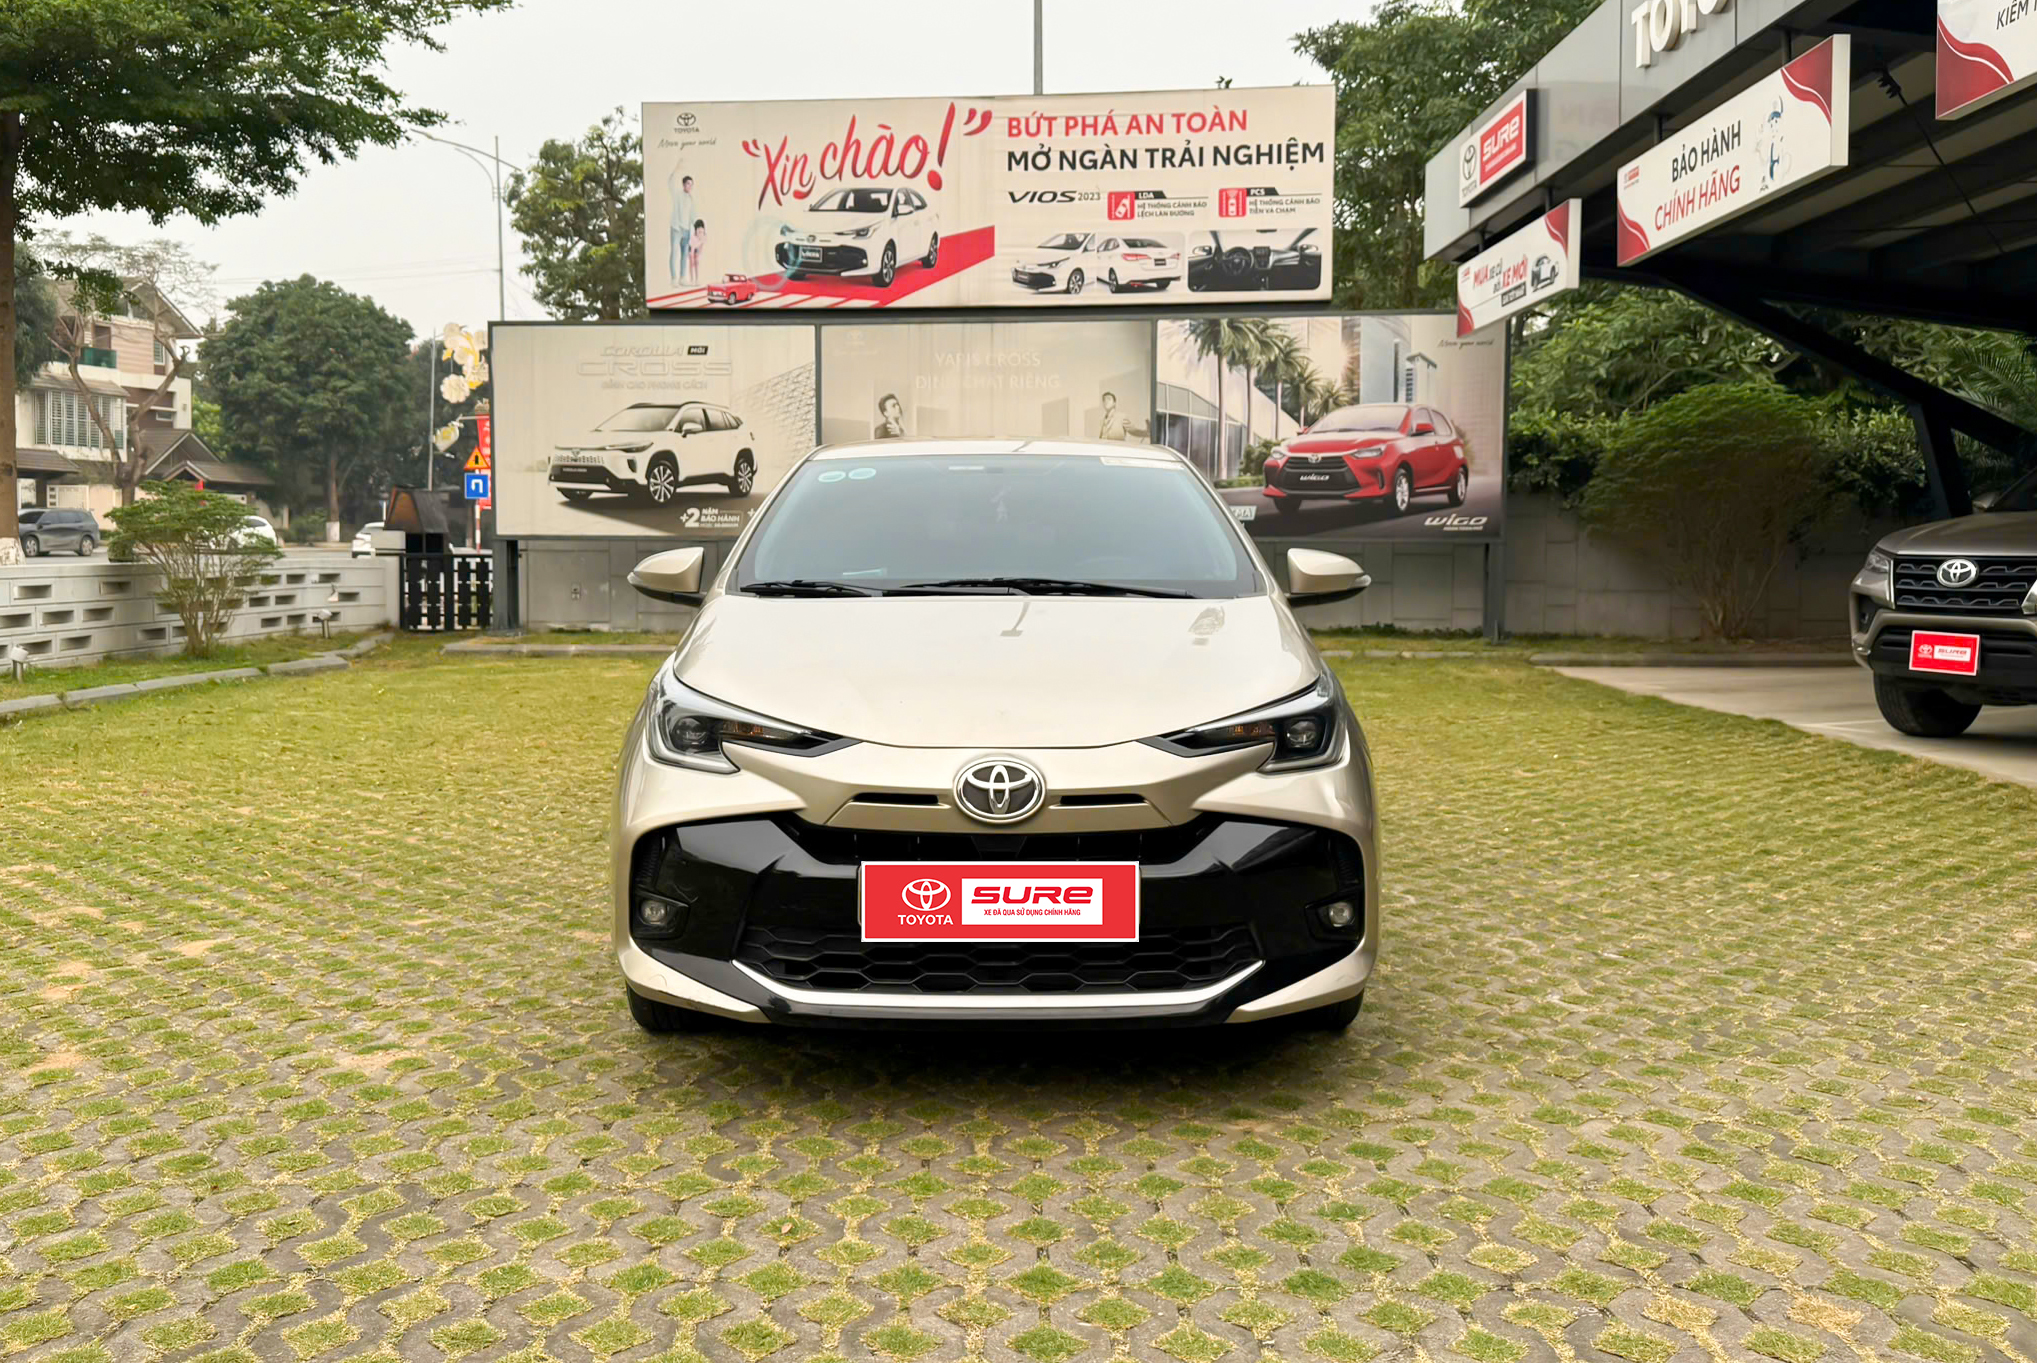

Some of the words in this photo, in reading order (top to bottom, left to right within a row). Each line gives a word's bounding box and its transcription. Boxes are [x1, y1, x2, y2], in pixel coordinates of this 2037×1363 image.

[1008, 110, 1058, 138] BỨT
[1064, 108, 1118, 136] PHÁ
[1126, 114, 1163, 136] AN
[1171, 105, 1247, 134] TOÀN
[1008, 143, 1051, 171] MỞ
[1059, 143, 1138, 170] NGÀN
[1145, 139, 1204, 169] TRẢI
[1212, 137, 1324, 171] NGHIỆM
[1482, 115, 1520, 162] SURE
[1672, 143, 1698, 183] BẢO
[1701, 119, 1741, 167] HÀNH
[1008, 191, 1077, 203] VIOS
[1078, 192, 1101, 201] 2023
[1654, 185, 1697, 231] CHÍNH
[1699, 164, 1741, 211] HÃNG
[577, 361, 733, 376] CROSS
[985, 352, 1041, 367] CROSS
